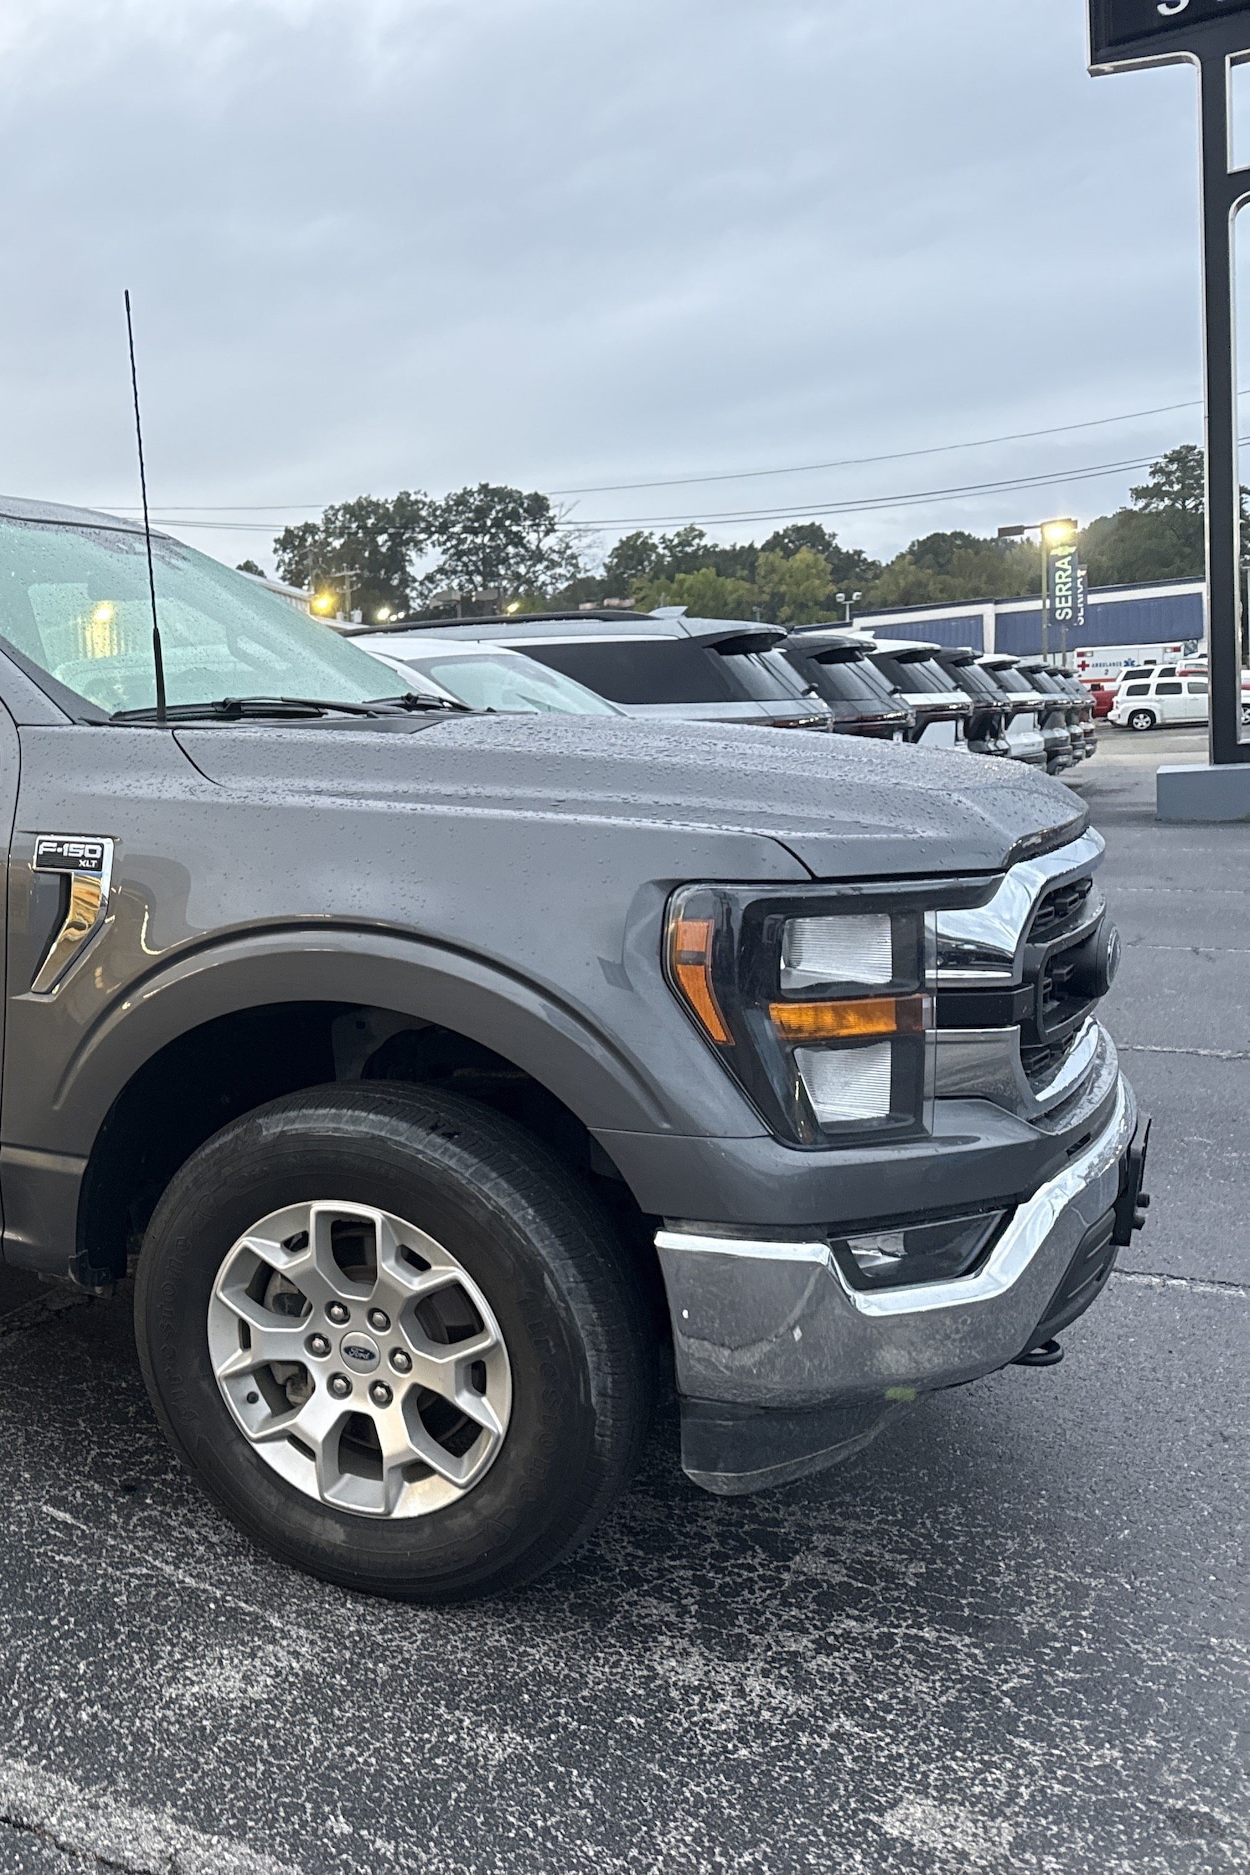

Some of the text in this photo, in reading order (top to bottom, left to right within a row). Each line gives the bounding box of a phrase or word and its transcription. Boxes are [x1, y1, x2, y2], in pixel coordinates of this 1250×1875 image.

[1055, 556, 1072, 620] SERRA
[38, 842, 102, 858] F-150
[78, 860, 98, 868] XLT
